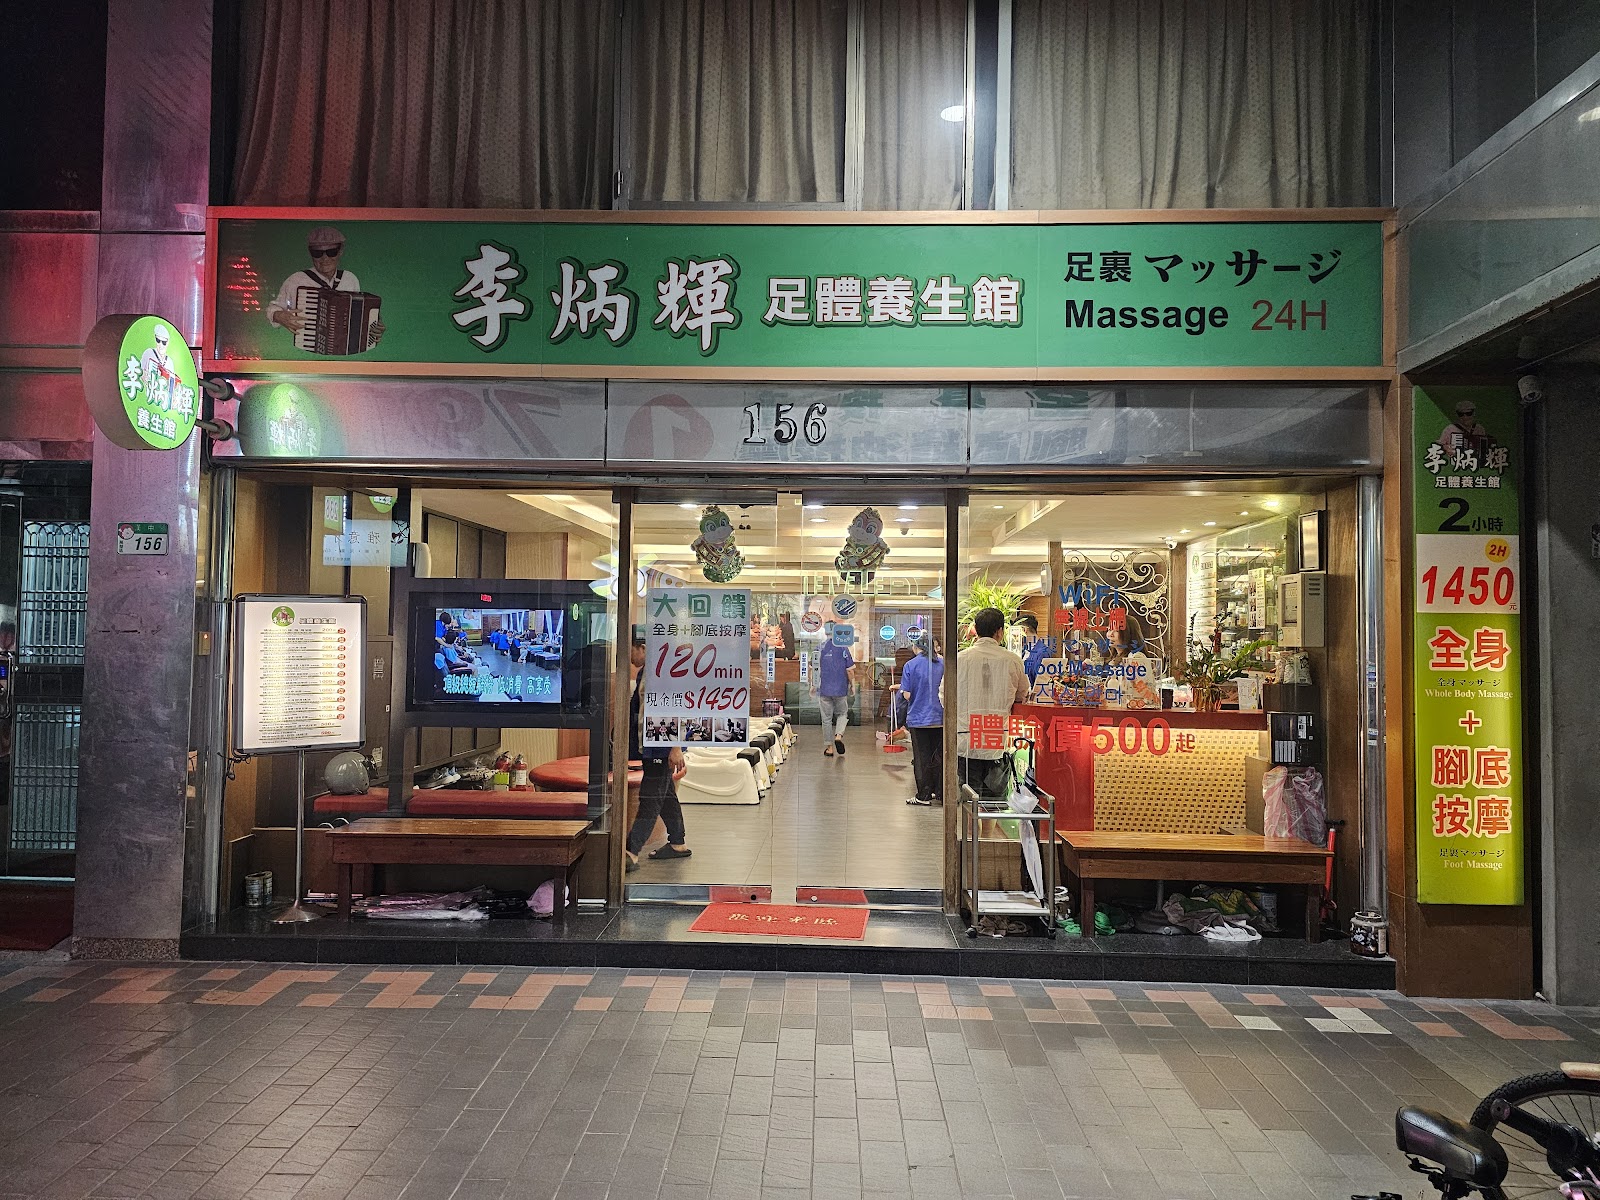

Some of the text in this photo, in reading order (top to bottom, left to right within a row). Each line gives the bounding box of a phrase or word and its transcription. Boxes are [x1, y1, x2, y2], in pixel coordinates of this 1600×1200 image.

[1144, 249, 1342, 287] マッサージ
[450, 244, 1022, 351] 李炳輝 足體養生館
[1065, 300, 1327, 335] Massage 24H
[123, 354, 195, 425] 李炳輝
[137, 407, 177, 441] 養生館
[744, 402, 828, 446] 156
[1423, 443, 1510, 474] 李炳輝
[1435, 475, 1501, 488] 足體養生館
[135, 537, 163, 551] 156
[1488, 543, 1507, 557] 2H
[1058, 584, 1120, 605] WiFi
[1421, 565, 1515, 606] 1450
[1054, 607, 1127, 631] 無線上網
[655, 642, 717, 678] 120
[714, 664, 743, 679] min
[1428, 627, 1511, 671] 全身
[1068, 660, 1147, 681] Massage
[646, 685, 748, 711] 現金價 $1450
[1425, 689, 1514, 700] Whole Body Massage
[1432, 746, 1511, 788] 腳底
[1433, 795, 1512, 837] 按摩
[1443, 859, 1503, 871] Foot Massage
